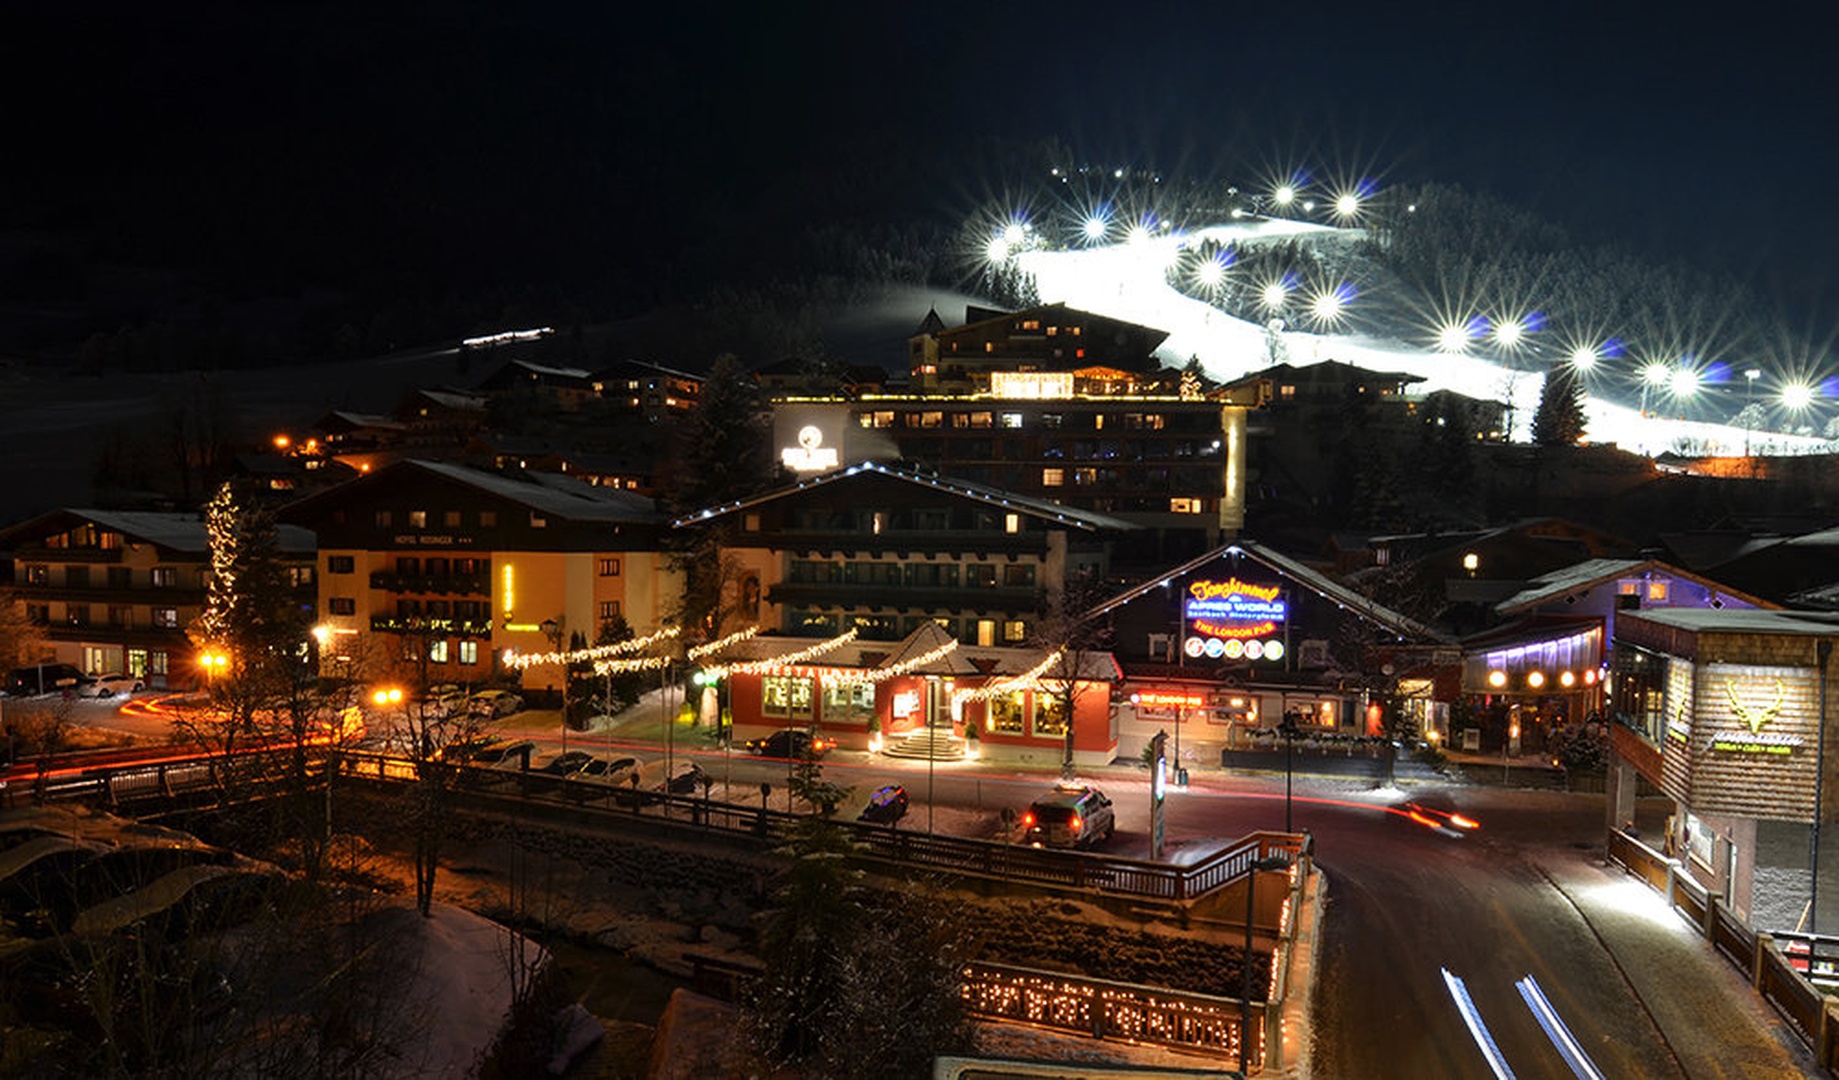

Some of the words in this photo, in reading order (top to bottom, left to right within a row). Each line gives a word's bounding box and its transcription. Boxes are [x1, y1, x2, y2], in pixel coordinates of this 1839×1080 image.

[395, 535, 417, 545] HOTEL
[1234, 602, 1285, 613] WORLD
[1195, 619, 1214, 635] THE
[1214, 626, 1254, 638] LONDON
[1254, 620, 1276, 635] PUB
